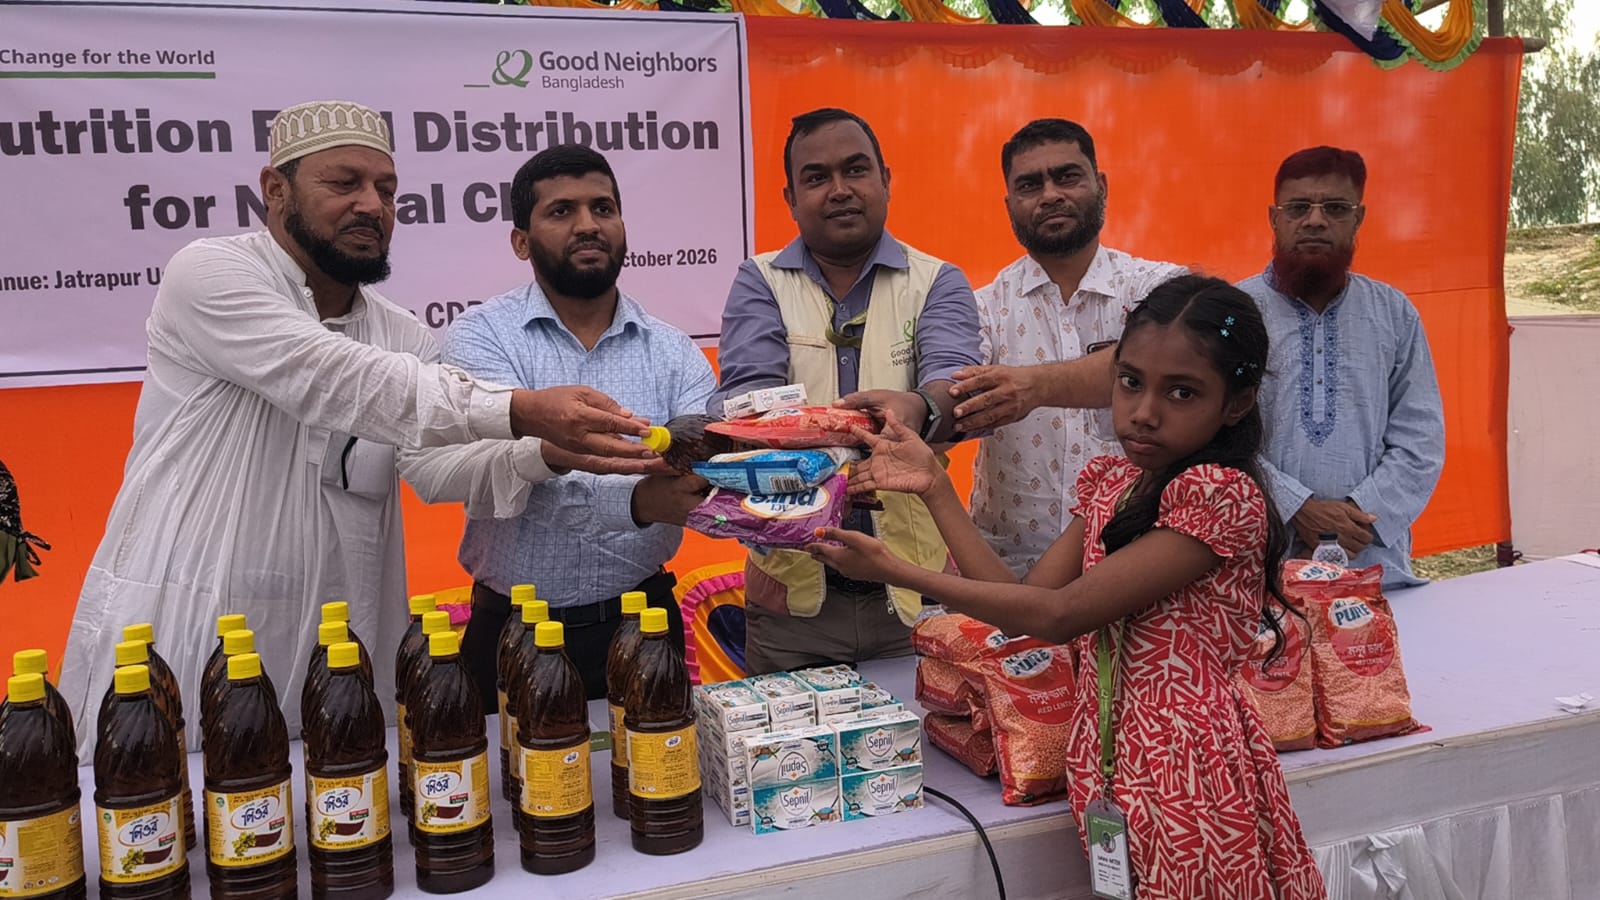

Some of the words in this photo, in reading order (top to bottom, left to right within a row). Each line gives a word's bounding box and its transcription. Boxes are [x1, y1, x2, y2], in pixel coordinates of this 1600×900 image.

[0, 49, 77, 68] Change
[82, 49, 112, 65] for
[117, 49, 151, 65] the
[156, 50, 215, 65] World
[539, 51, 599, 71] Good
[604, 52, 718, 77] Neighbors
[541, 75, 625, 92] Bangladesh
[0, 108, 233, 155] utrition
[413, 110, 720, 152] Distribution
[123, 184, 216, 230] for
[622, 251, 673, 268] ctober
[676, 248, 718, 266] 2026
[0, 274, 49, 291] nue:
[54, 270, 142, 291] Jatrapur
[890, 345, 912, 359] Good
[1335, 603, 1371, 626] PURE
[868, 733, 893, 749] Sepnil
[781, 760, 807, 777] Sepnil
[870, 778, 895, 795] Sepnil
[783, 790, 809, 808] Sepnil
